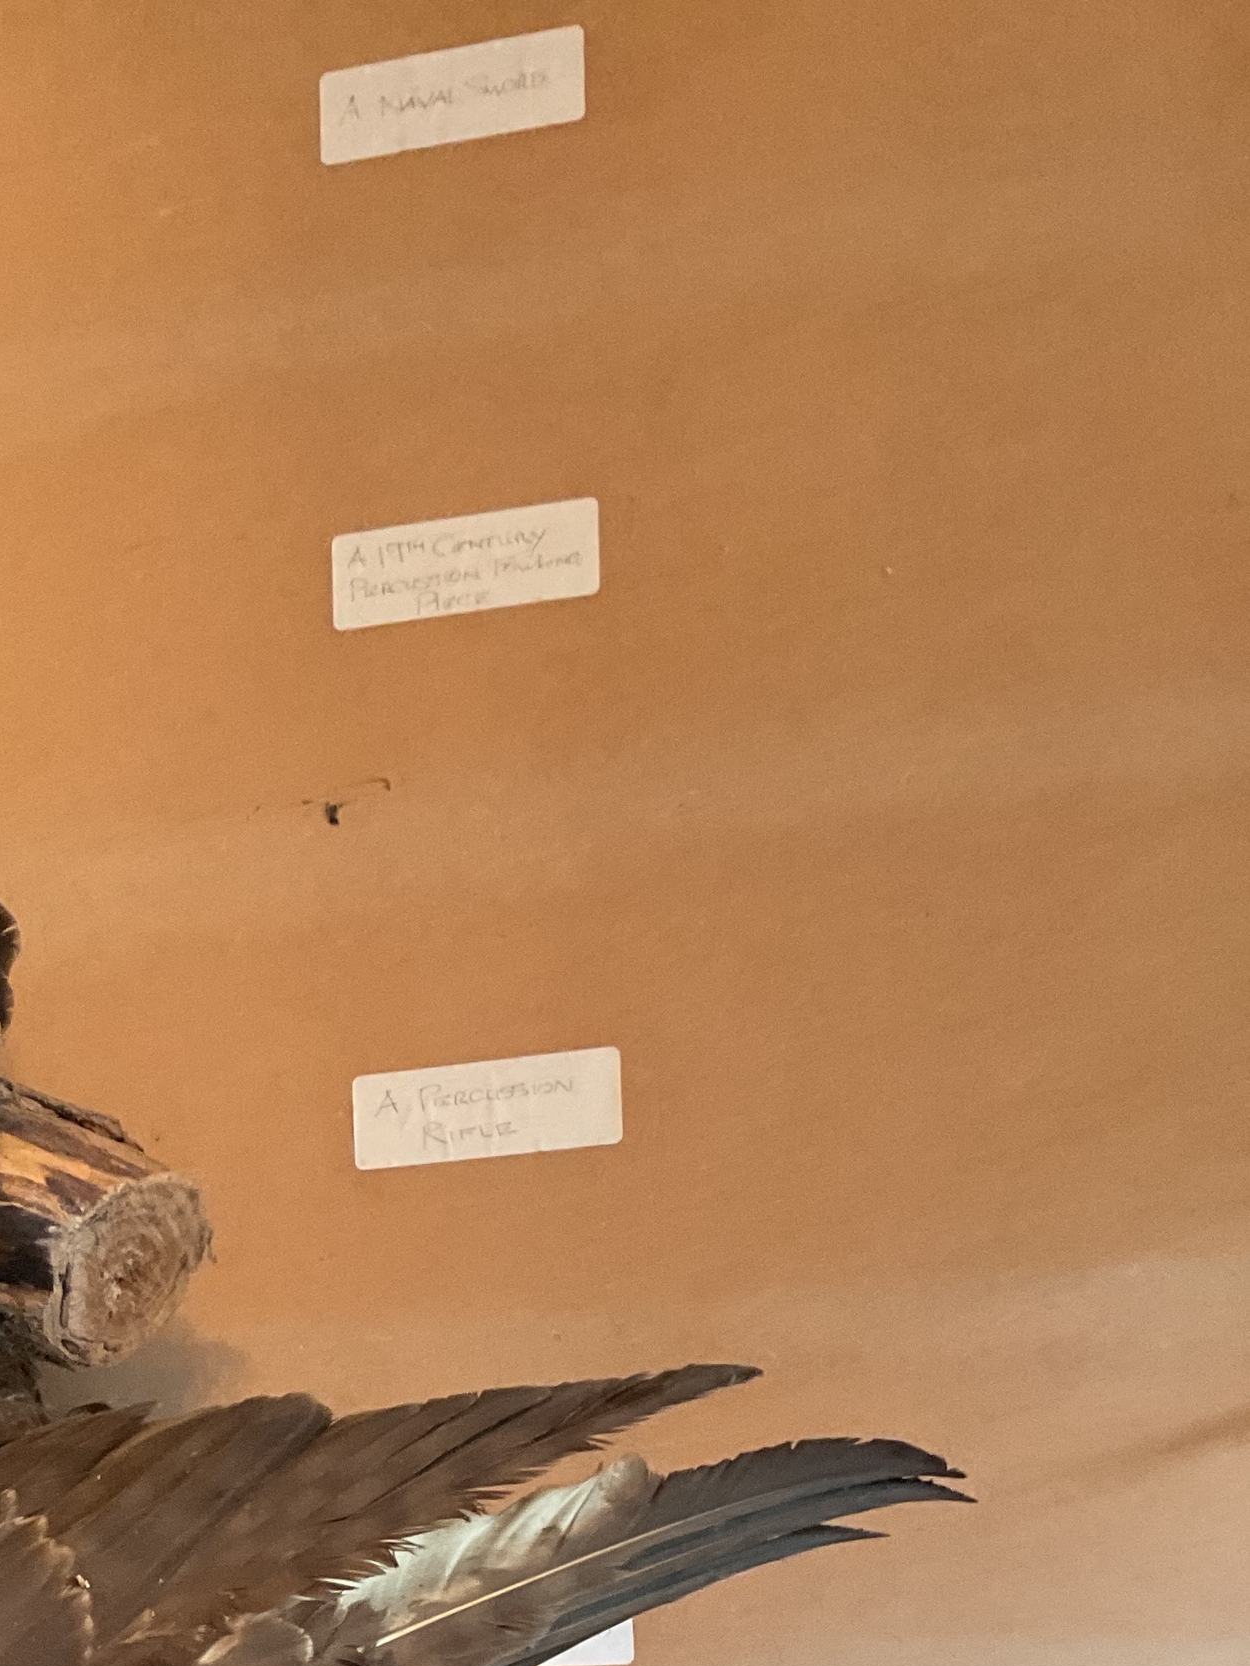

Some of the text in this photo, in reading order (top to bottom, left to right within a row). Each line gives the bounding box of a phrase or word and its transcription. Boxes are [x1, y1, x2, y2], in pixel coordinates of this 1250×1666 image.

[339, 95, 359, 125] A
[348, 547, 366, 568] A
[375, 1079, 572, 1117] A PERCUSSION
[423, 1122, 517, 1149] RIFLE
